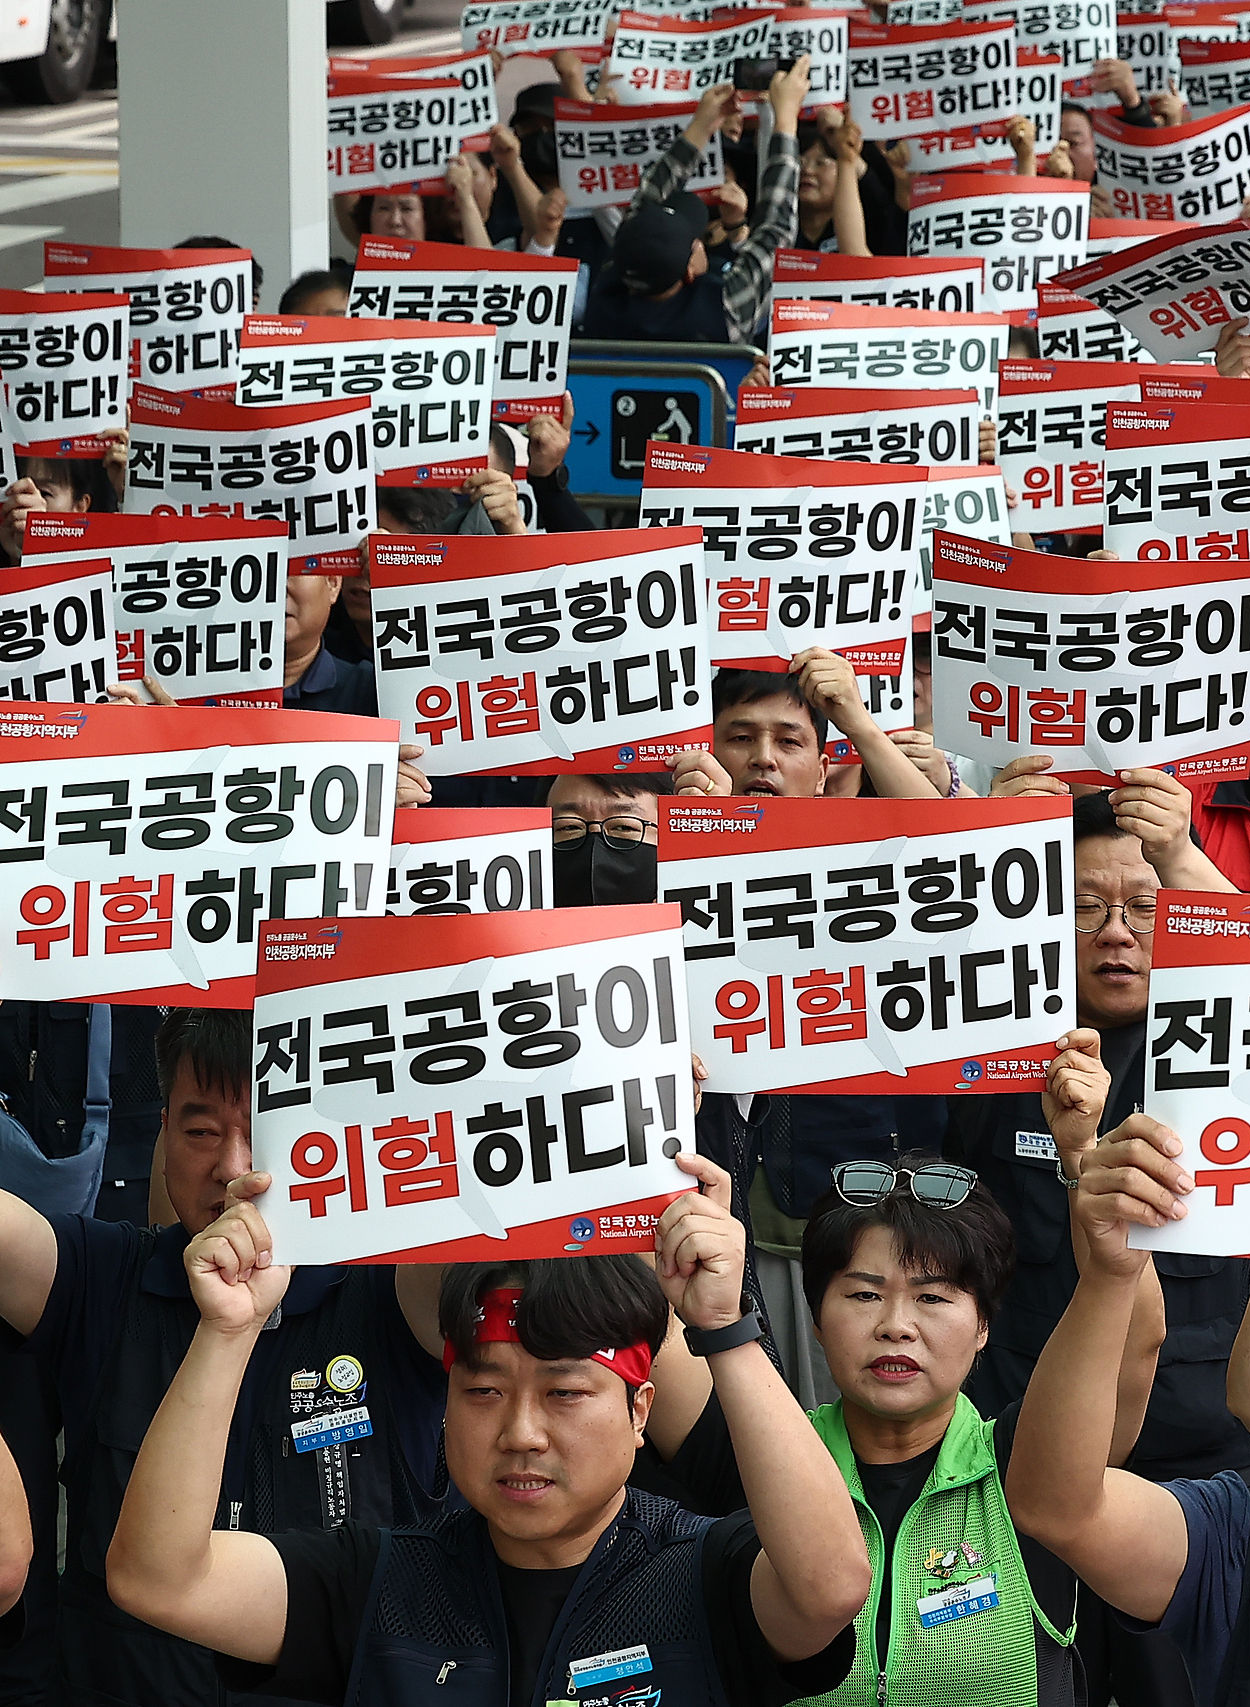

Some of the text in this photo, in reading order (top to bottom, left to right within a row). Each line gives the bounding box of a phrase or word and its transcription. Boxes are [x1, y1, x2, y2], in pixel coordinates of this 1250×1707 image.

[850, 39, 1012, 88] 전국공항이
[328, 97, 454, 136] 국공항이
[872, 80, 1012, 124] 위험하다!
[558, 121, 684, 160] 전국공항
[909, 205, 1083, 257] 전국공항이
[130, 274, 246, 326] 공항이
[0, 319, 122, 371] 공항이
[774, 338, 999, 386] 전국공항이
[14, 374, 119, 422] 하다!
[240, 348, 486, 403] 전국공항이
[372, 399, 481, 449] 하다!
[1112, 418, 1170, 430] 인천공항지역지부
[128, 423, 369, 491] 전국공항이
[112, 551, 277, 614] 공항이
[376, 553, 443, 566] 인천공항지역지부
[940, 548, 1006, 573] 인천공항지역지부
[376, 562, 698, 673] 전국공항이
[709, 569, 907, 632] 험하다!
[116, 620, 274, 681] 험하다!
[415, 645, 700, 746] 위험하다!
[968, 671, 1247, 747] 위험하다!
[0, 722, 79, 738] 천공항지역지부
[0, 762, 384, 864] 전국공항이
[668, 818, 757, 833] 인천공항지역지부
[17, 861, 374, 961] 위험하다!
[664, 840, 1064, 962] 전국공항이
[264, 943, 336, 961] 인천공항지역지부
[713, 940, 1063, 1054] 위험하다!
[255, 955, 678, 1115] 전국공항이
[986, 1059, 1051, 1071] 전국공항노동
[987, 1071, 1011, 1080] National
[1011, 1071, 1032, 1081] Airport
[289, 1074, 682, 1219] 위험하다!
[599, 1214, 660, 1229] 전국공항노
[600, 1228, 652, 1239] National Airport
